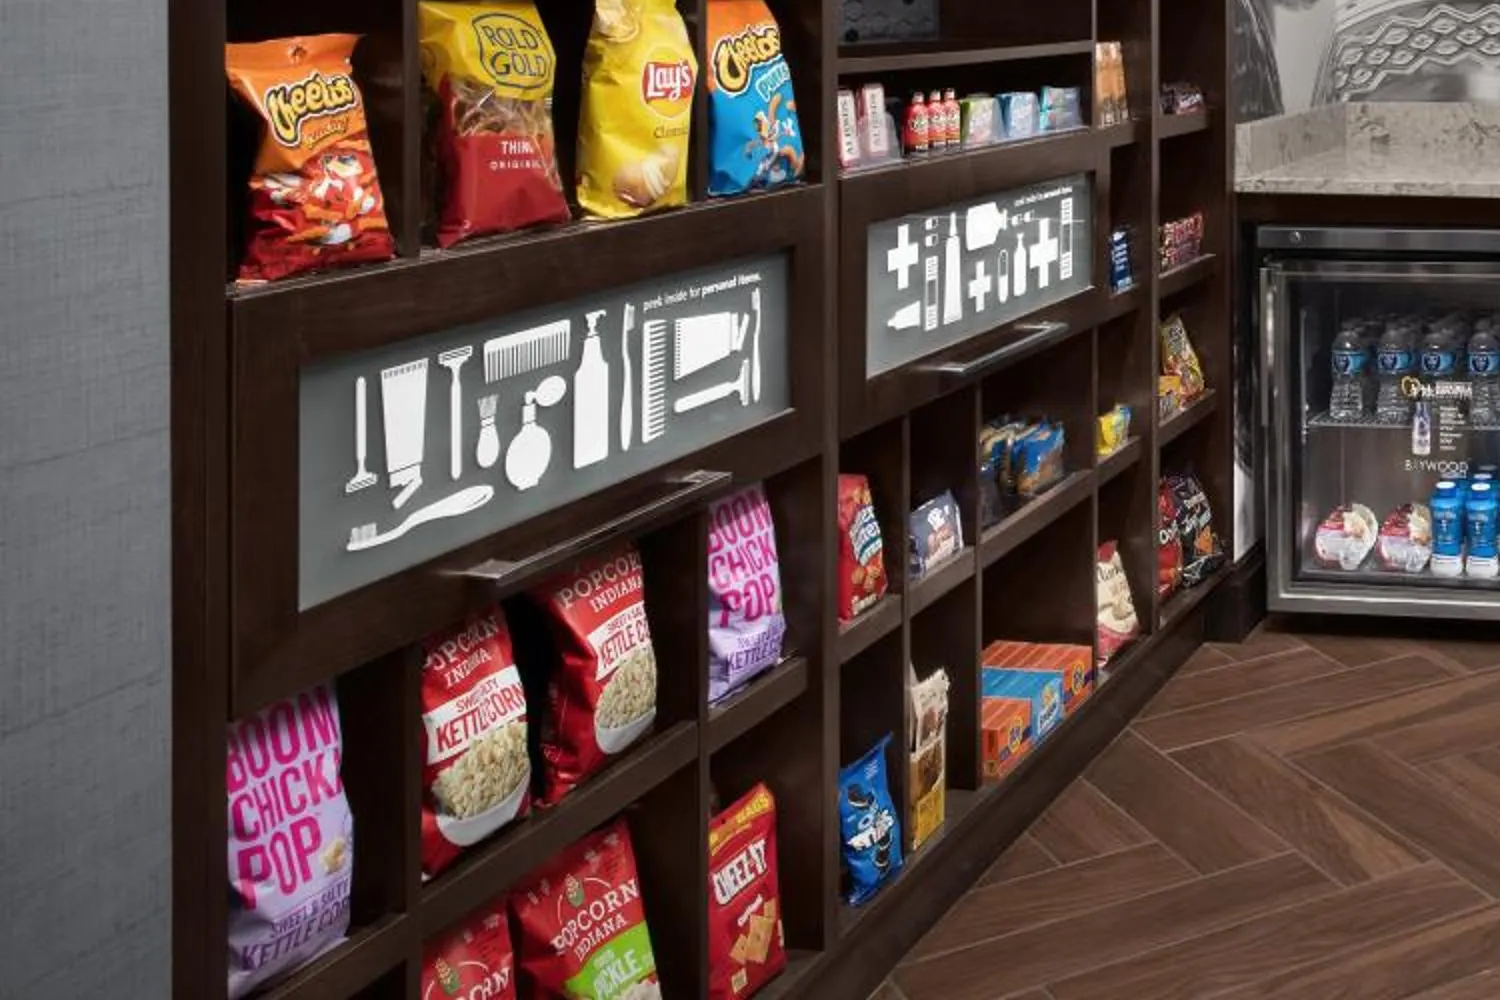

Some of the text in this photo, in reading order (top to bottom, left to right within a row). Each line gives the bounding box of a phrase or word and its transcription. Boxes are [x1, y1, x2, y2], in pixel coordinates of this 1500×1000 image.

[482, 25, 540, 50] ROLD
[490, 51, 546, 77] GOLD
[714, 27, 781, 98] Cheetos
[264, 70, 357, 146] Cheetos
[646, 58, 692, 100] Lay's
[701, 275, 737, 299] personal
[720, 576, 776, 629] POP
[226, 684, 339, 796] BOOM
[235, 813, 324, 912] POP
[241, 914, 316, 973] KETTLE
[550, 878, 639, 956] POPCORN
